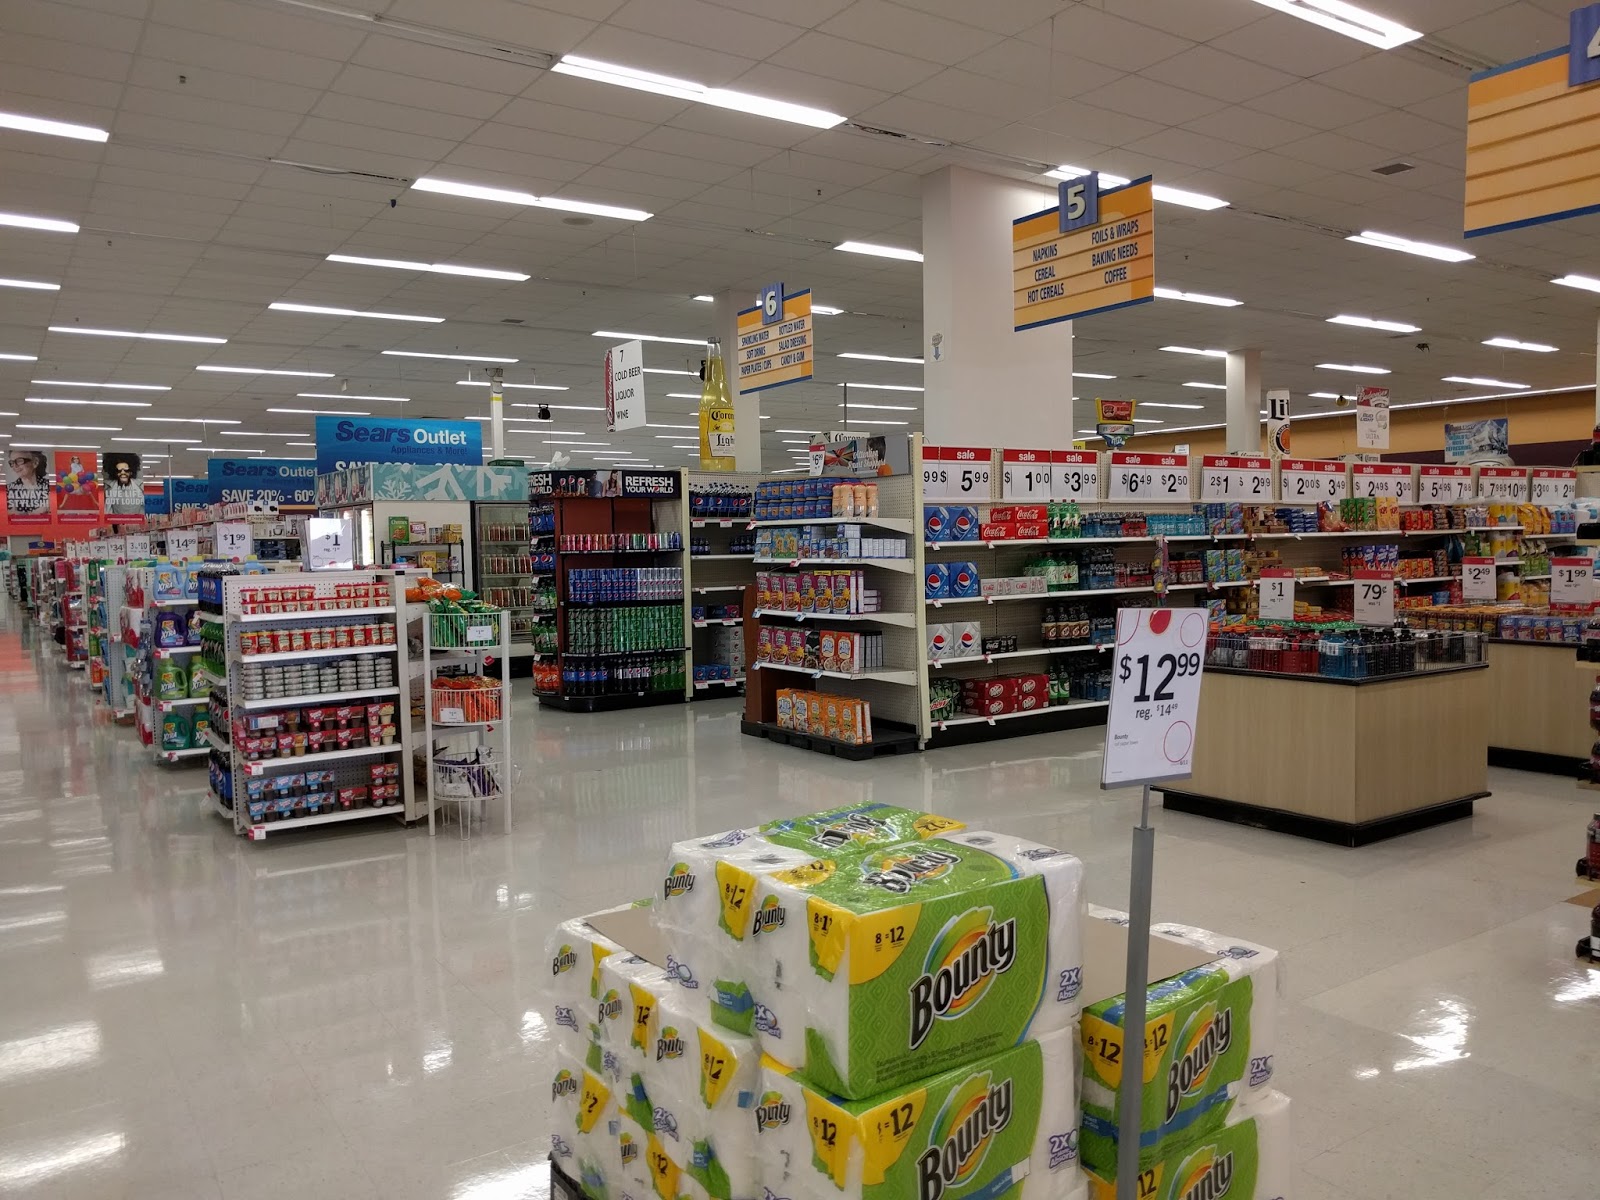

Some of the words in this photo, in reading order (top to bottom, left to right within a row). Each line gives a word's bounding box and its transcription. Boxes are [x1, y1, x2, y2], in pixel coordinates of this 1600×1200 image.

[1067, 183, 1086, 220] 5
[1092, 229, 1108, 245] FOILS
[1110, 227, 1115, 239] &
[1117, 219, 1139, 237] WRAPS
[1033, 244, 1058, 262] NAPKINS
[1092, 249, 1116, 267] BAKING
[1118, 242, 1138, 259] NEEDS
[1034, 266, 1056, 282] CEREAL
[1104, 267, 1127, 284] COFFEE
[1027, 287, 1039, 303] HOT
[1040, 283, 1065, 300] CEREALS
[766, 291, 777, 316] 6
[794, 319, 806, 332] WATER
[741, 332, 759, 346] SPARKLING
[759, 330, 770, 342] WATER
[779, 339, 790, 351] SALAD
[790, 335, 807, 348] DRESSING
[619, 350, 624, 363] 7
[746, 350, 754, 360] SOFT
[754, 346, 766, 358] DRINKS
[781, 355, 793, 366] CANDY
[615, 370, 628, 382] COLD
[628, 366, 641, 378] BEER
[741, 365, 751, 376] PAPER
[615, 388, 635, 401] LIQUOR
[616, 409, 629, 420] WINE
[336, 421, 411, 443] Sears
[413, 428, 467, 445] Outlet
[716, 433, 735, 447] Ligh
[391, 445, 435, 455] Appliances
[445, 447, 468, 455] More!
[956, 449, 975, 460] sale
[1018, 451, 1036, 462] sale
[1066, 453, 1082, 463] sale
[1125, 455, 1141, 464] sale
[1161, 456, 1176, 466] sale
[1214, 458, 1229, 467] sale
[1247, 460, 1260, 469] sale
[222, 461, 277, 477] Sears
[279, 466, 318, 477] Outlet
[1291, 462, 1304, 470] sale
[1324, 463, 1336, 471] sale
[1362, 465, 1374, 474] sale
[1392, 466, 1403, 475] sale
[1429, 467, 1440, 475] sale
[1454, 467, 1464, 476] sale
[1487, 468, 1497, 476] sale
[175, 481, 208, 493] Sear
[625, 476, 673, 487] REFRESH
[1064, 471, 1097, 492] $399
[8, 490, 49, 500] ALWAYS
[105, 490, 123, 498] LIVE
[125, 490, 143, 498] LIFE
[222, 489, 254, 502] SAVE
[257, 490, 285, 502] 20%
[223, 534, 246, 546] $199
[1468, 567, 1491, 580] $249
[1558, 569, 1587, 583] $199
[1271, 582, 1284, 597] $1
[1361, 584, 1387, 600] 79¢
[1119, 653, 1201, 703] $1299
[1135, 708, 1153, 721] reg.
[910, 917, 1016, 1048] Bounty
[1166, 1007, 1232, 1124] Bounty
[1251, 1057, 1267, 1073] 2X
[917, 1079, 1012, 1200] Bounty
[1050, 1136, 1070, 1153] 2X
